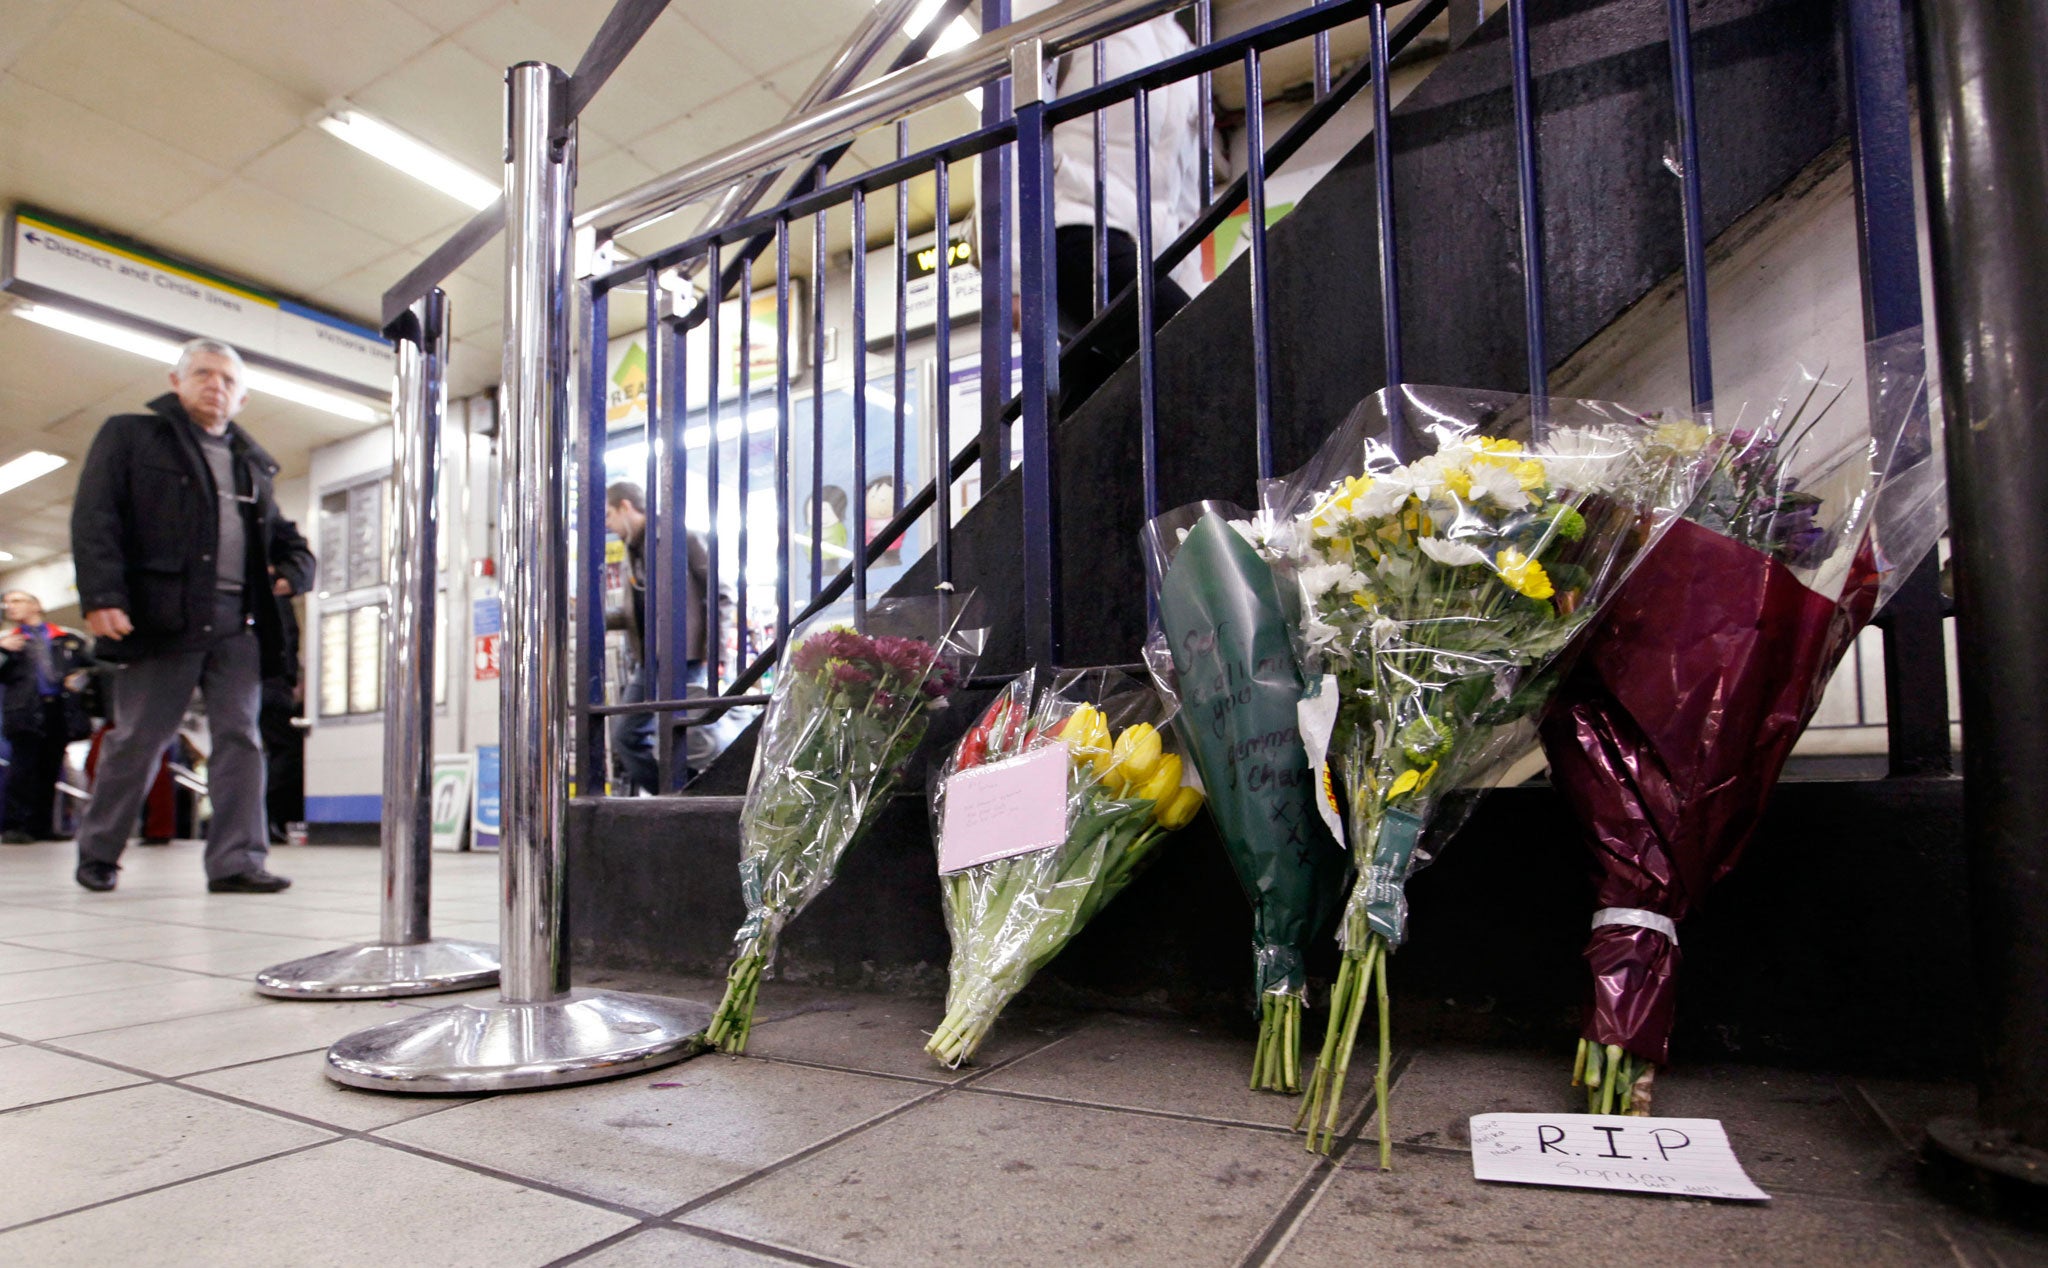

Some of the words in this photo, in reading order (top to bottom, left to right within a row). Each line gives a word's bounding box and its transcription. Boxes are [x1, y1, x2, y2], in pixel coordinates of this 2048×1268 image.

[43, 235, 113, 272] District
[118, 263, 149, 283] and
[153, 273, 201, 300] Circle
[205, 290, 242, 313] lines
[315, 325, 366, 352] Victoria
[1212, 686, 1252, 739] you
